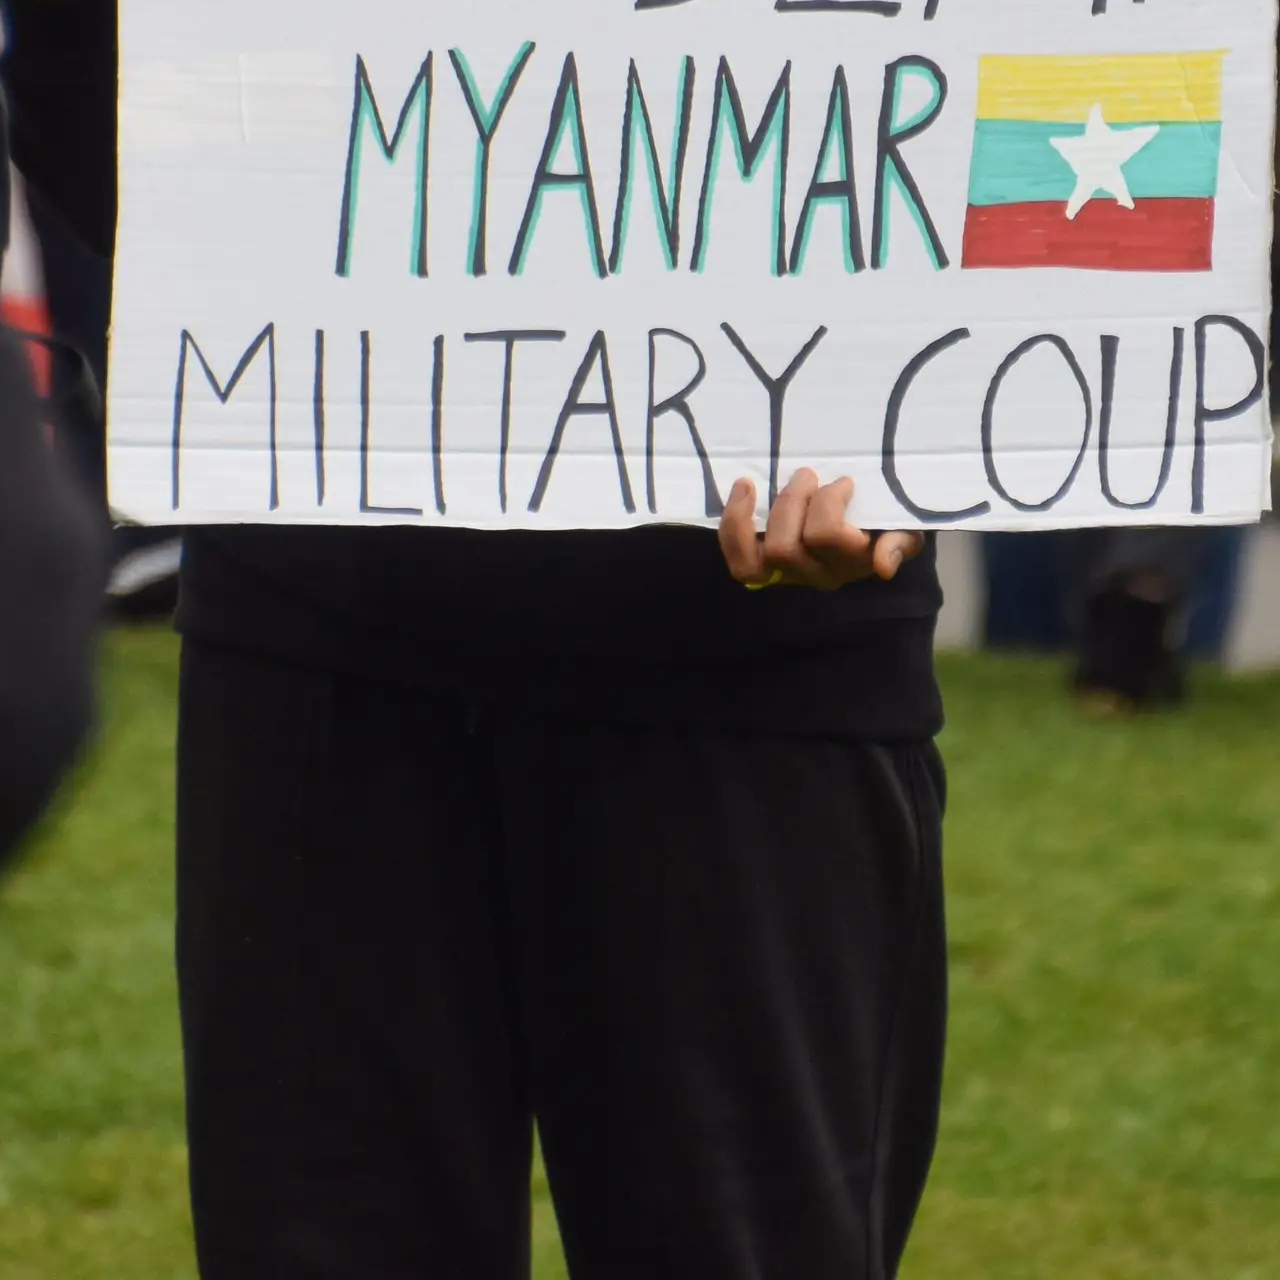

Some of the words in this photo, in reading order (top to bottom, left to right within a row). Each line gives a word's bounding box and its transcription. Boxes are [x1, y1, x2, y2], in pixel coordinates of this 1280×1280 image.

[334, 38, 950, 278] MYANMAR
[171, 321, 828, 515] MILITARY
[880, 314, 1266, 518] COUP
